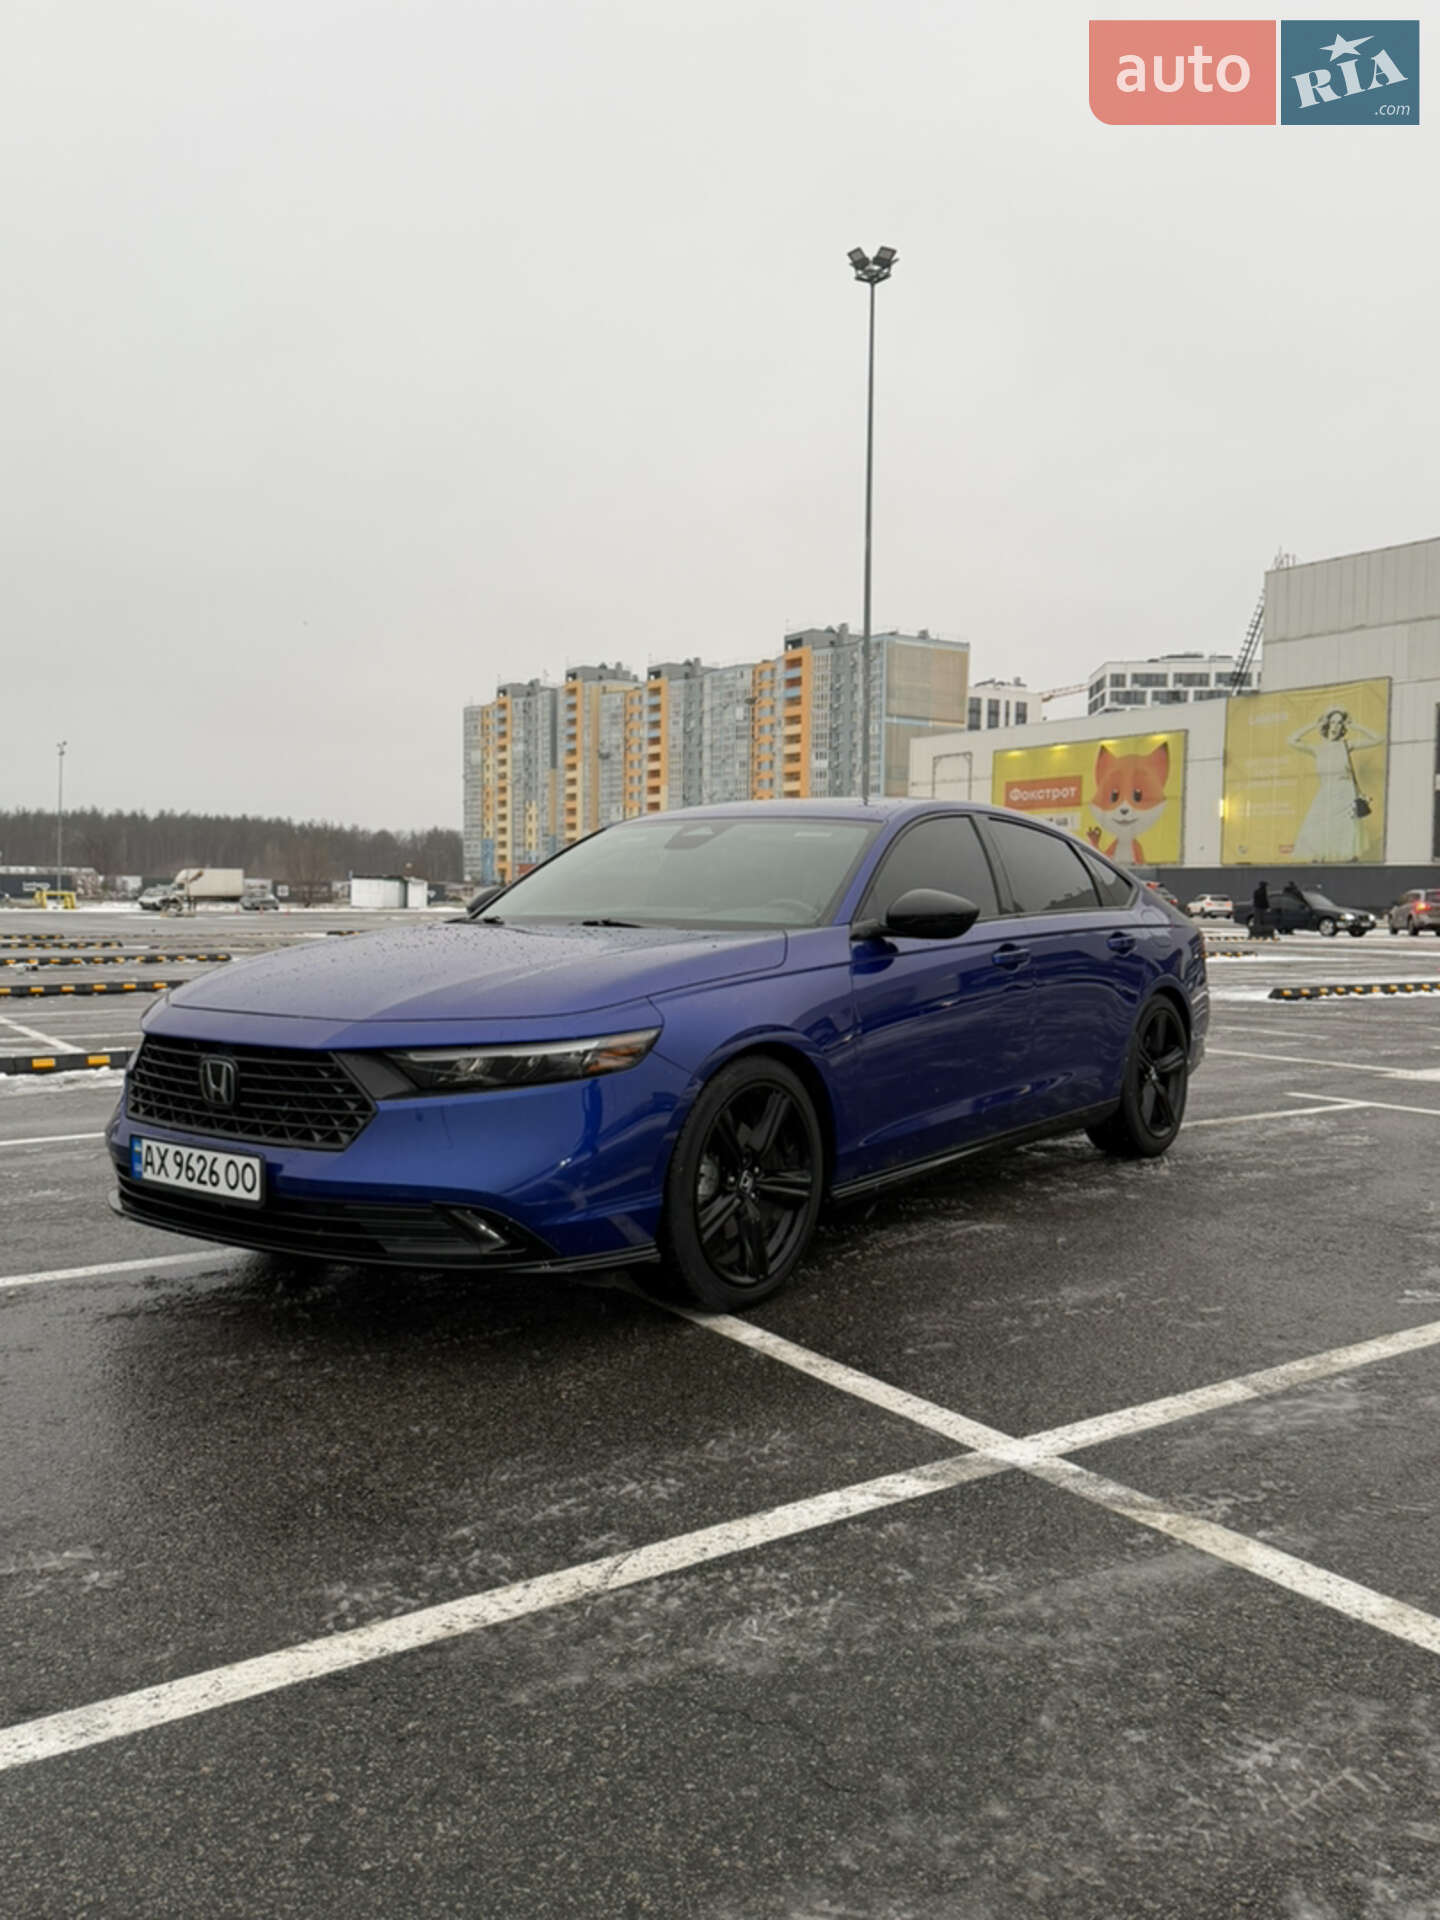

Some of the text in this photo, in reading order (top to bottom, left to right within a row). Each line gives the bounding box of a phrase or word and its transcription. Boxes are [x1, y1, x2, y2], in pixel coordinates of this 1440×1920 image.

[1009, 785, 1078, 801] Фокстрот
[143, 1144, 170, 1179] AX
[173, 1150, 221, 1187] 9626
